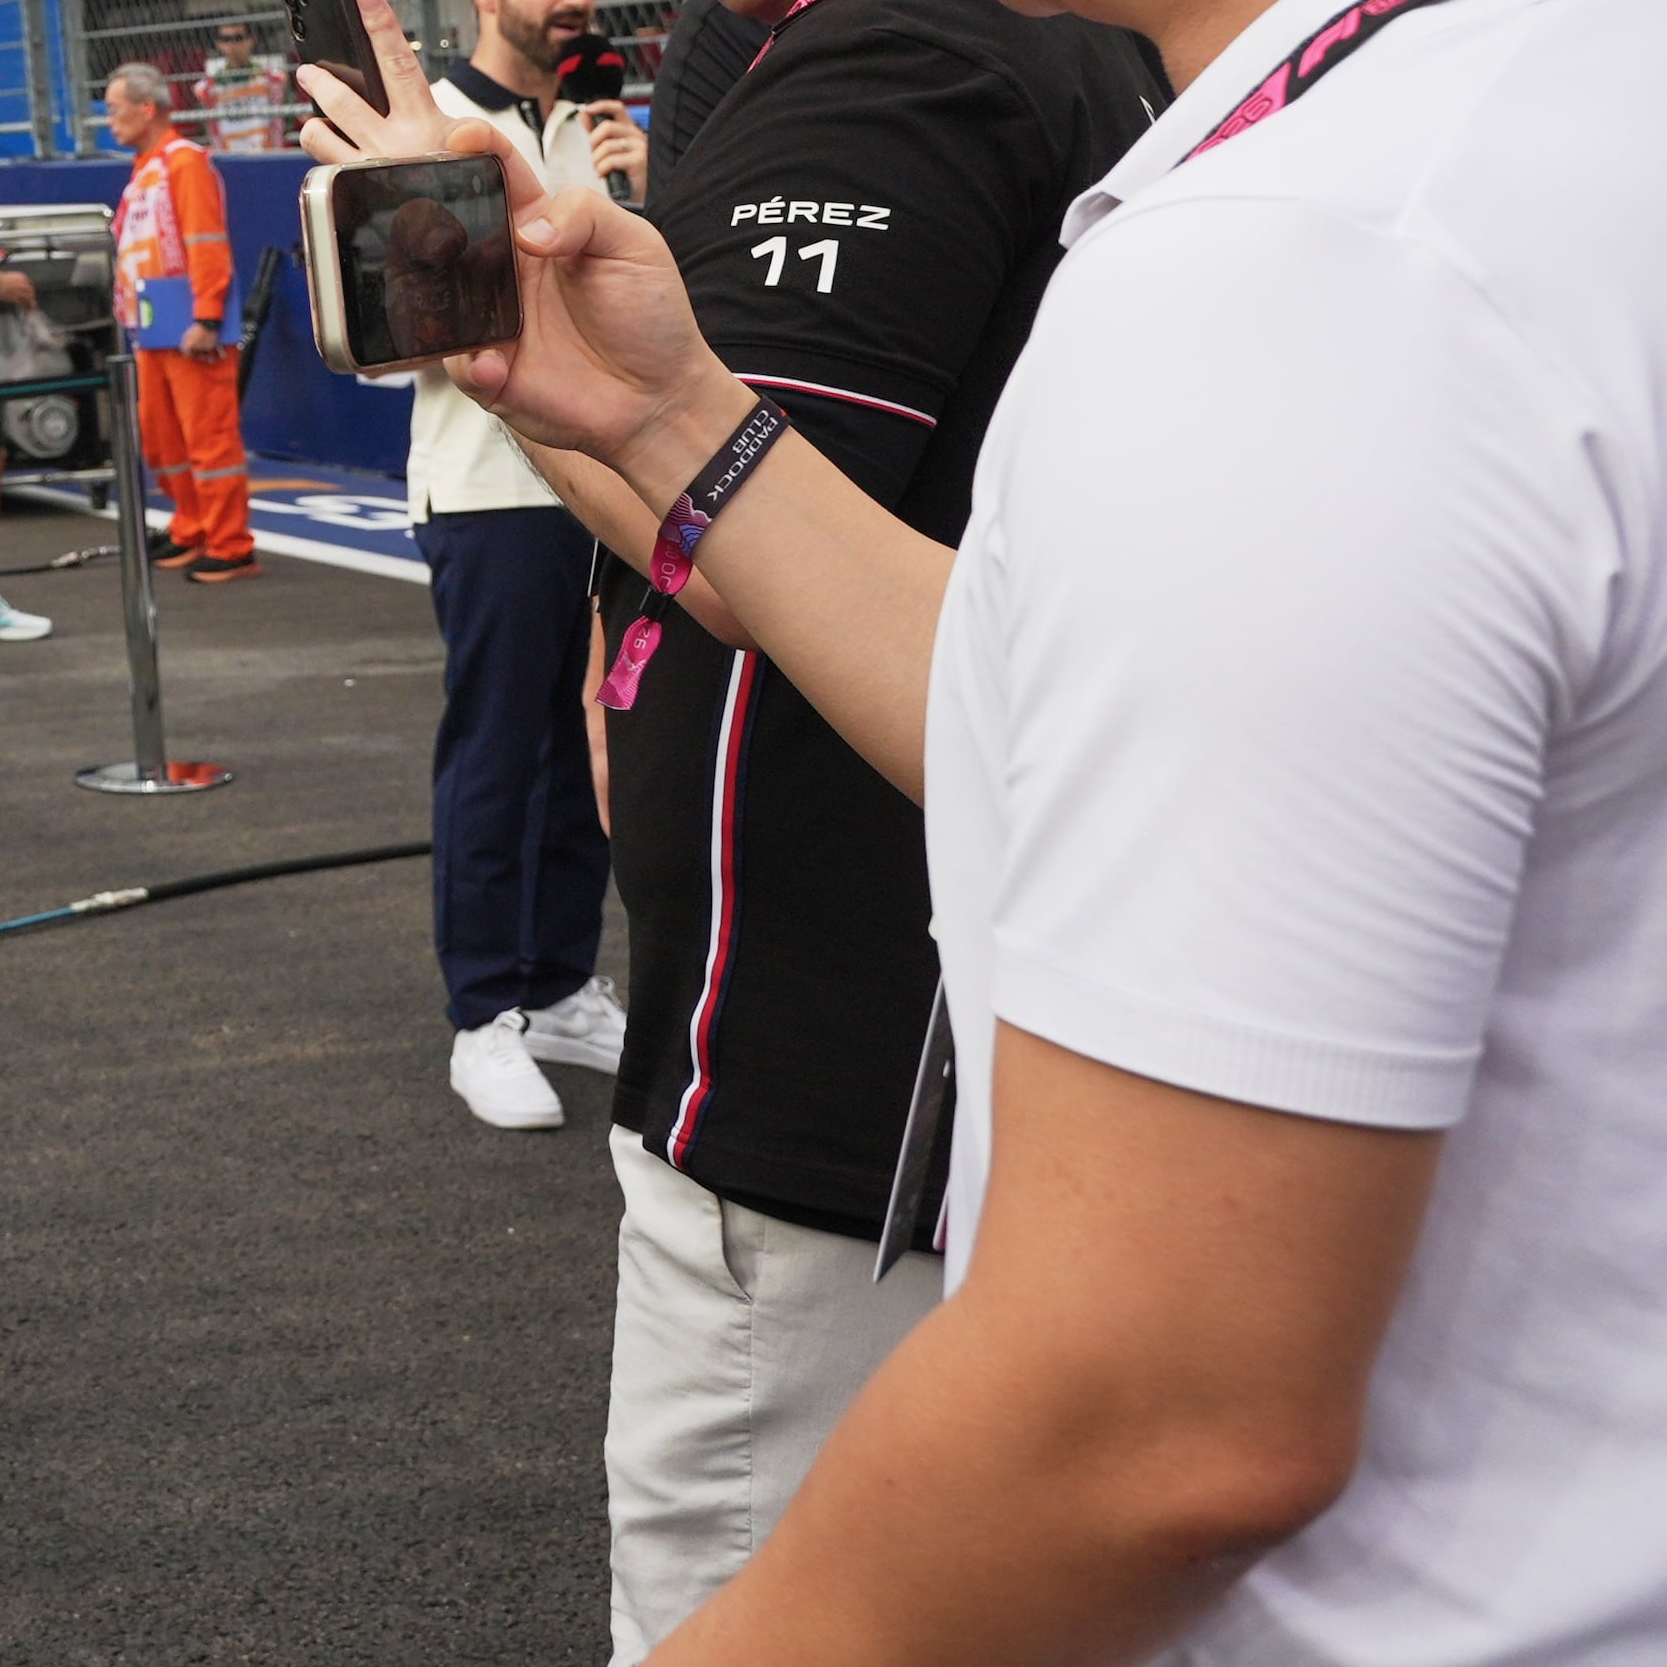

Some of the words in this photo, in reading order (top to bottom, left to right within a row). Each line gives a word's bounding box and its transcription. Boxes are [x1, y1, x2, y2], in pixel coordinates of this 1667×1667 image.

[730, 195, 892, 231] PÉREZ
[750, 235, 840, 294] 11
[732, 408, 770, 454] CLUB
[707, 415, 779, 503] PADDOCK
